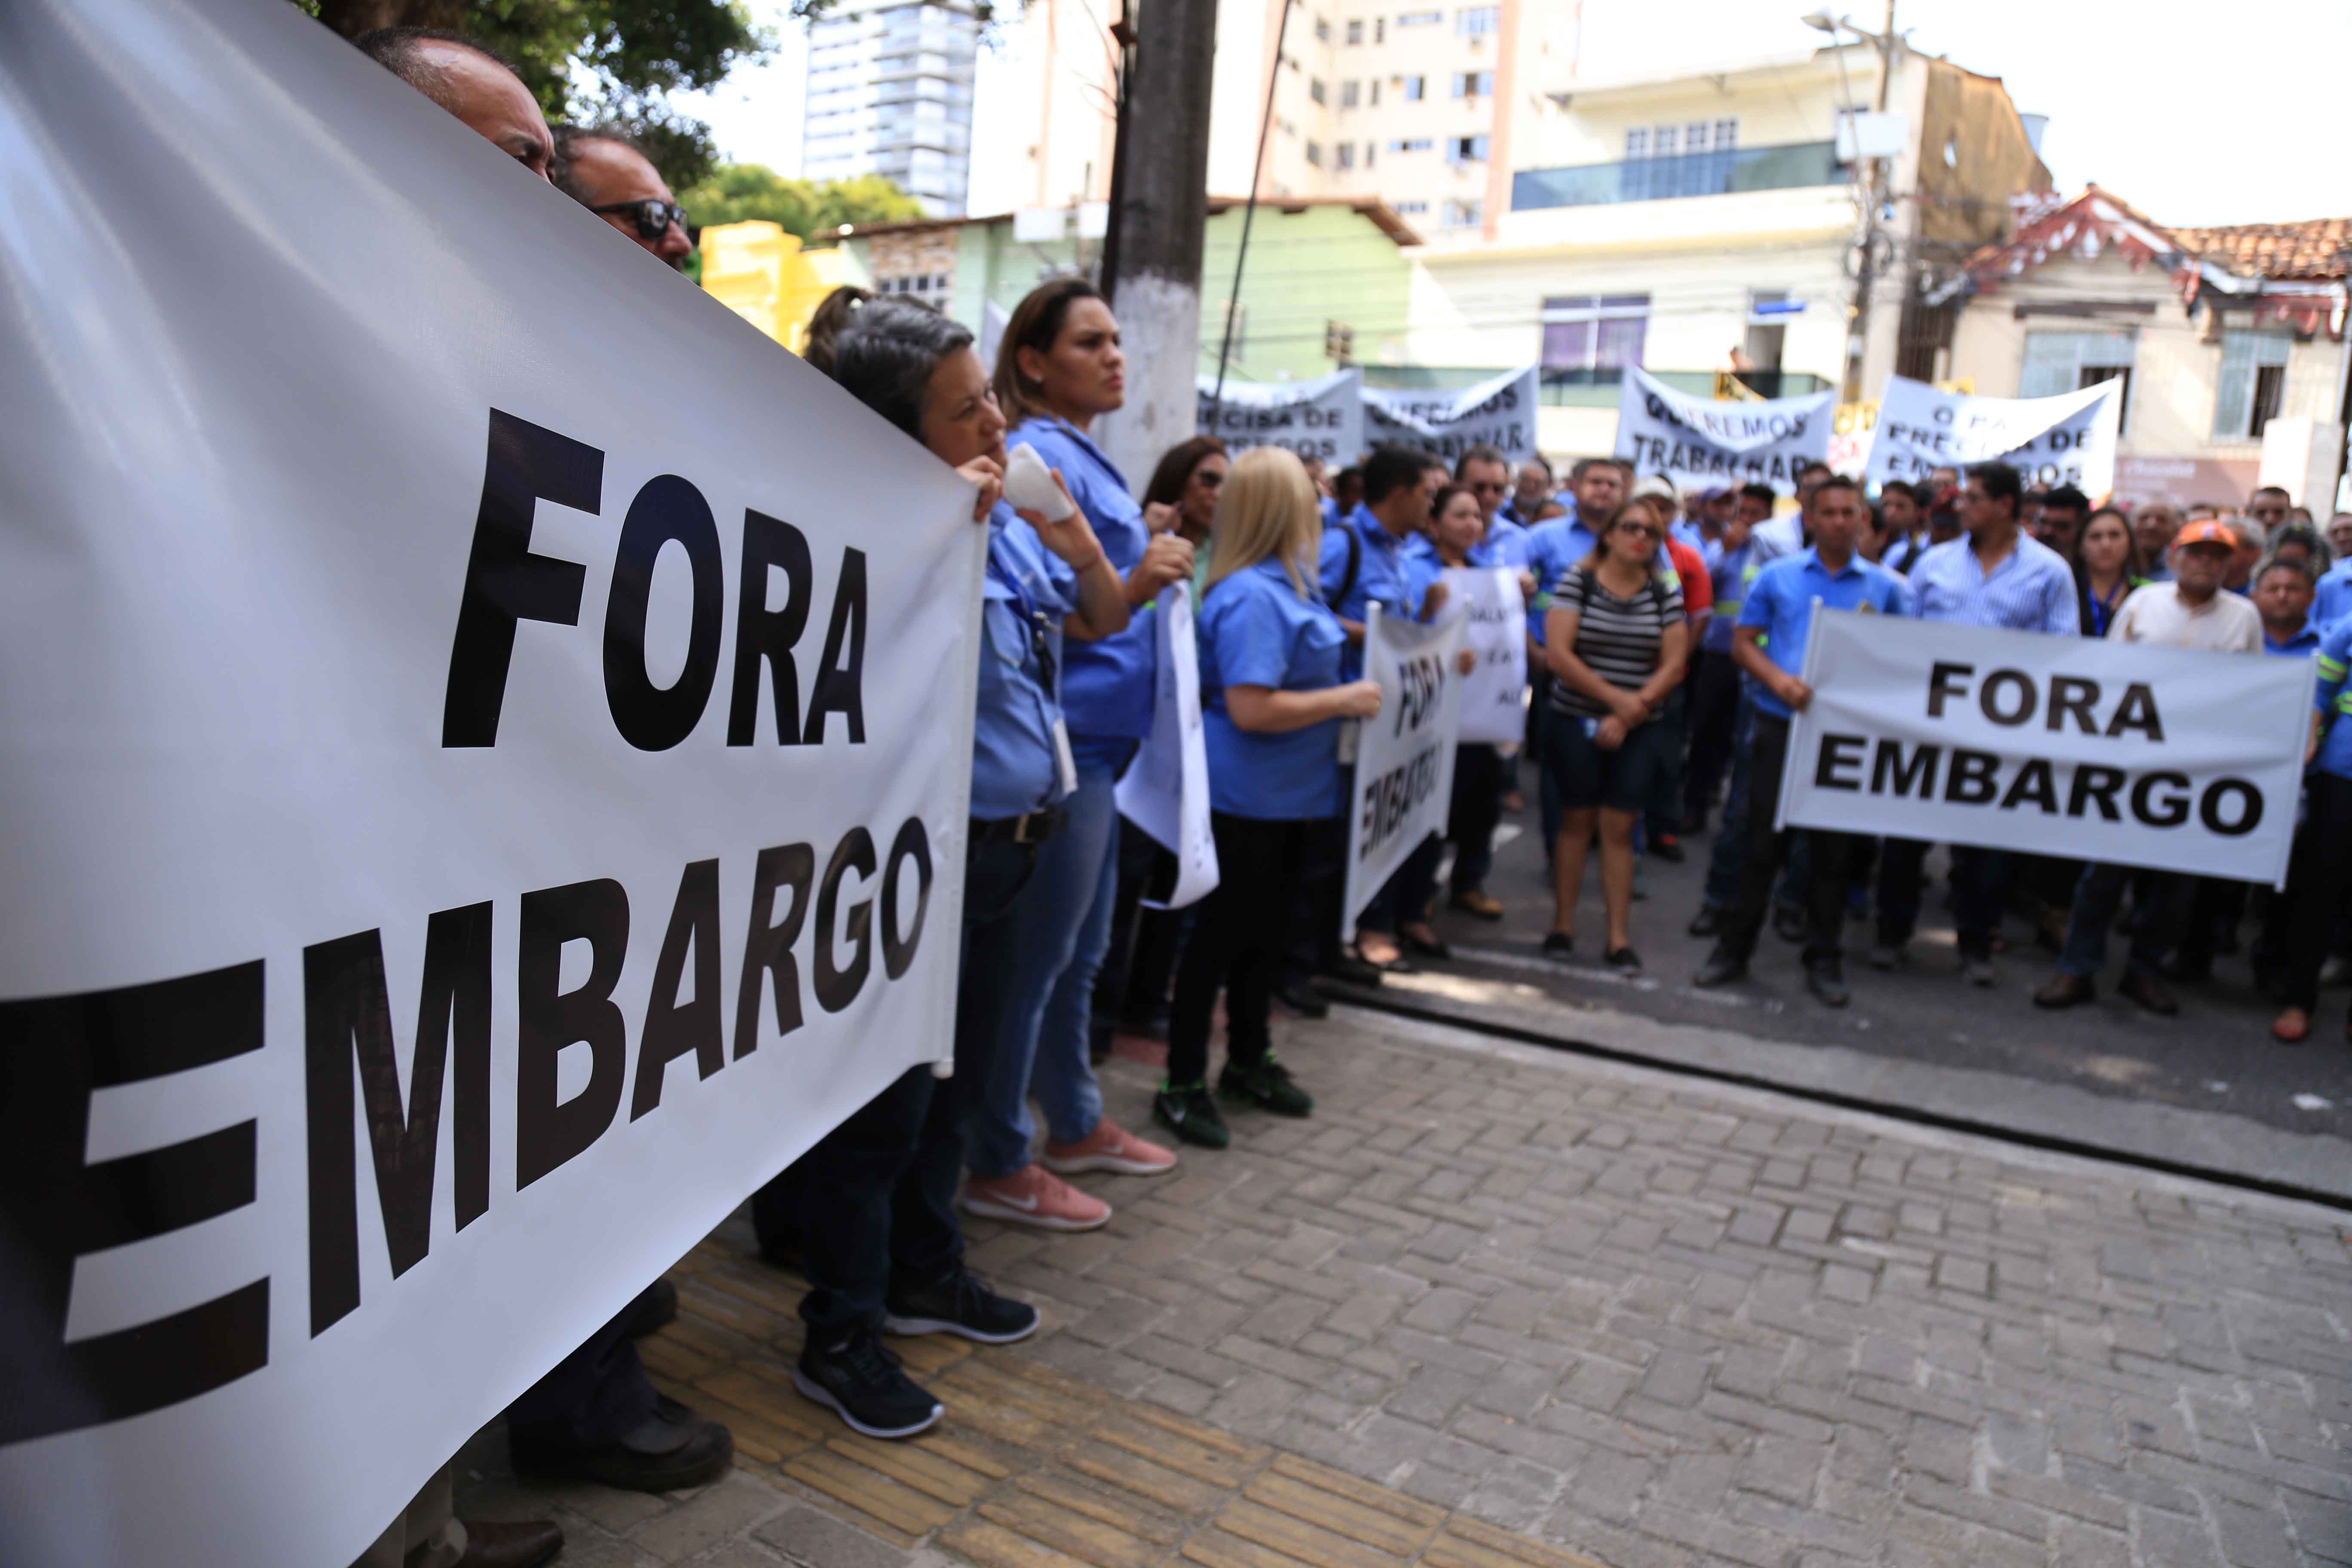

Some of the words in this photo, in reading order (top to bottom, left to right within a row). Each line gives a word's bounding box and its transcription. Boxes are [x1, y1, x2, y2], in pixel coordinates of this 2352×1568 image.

[441, 406, 868, 753] FORA
[1813, 732, 2264, 838] EMBARGO
[1926, 661, 2165, 743] FORA
[0, 815, 933, 1449] EMBARGO
